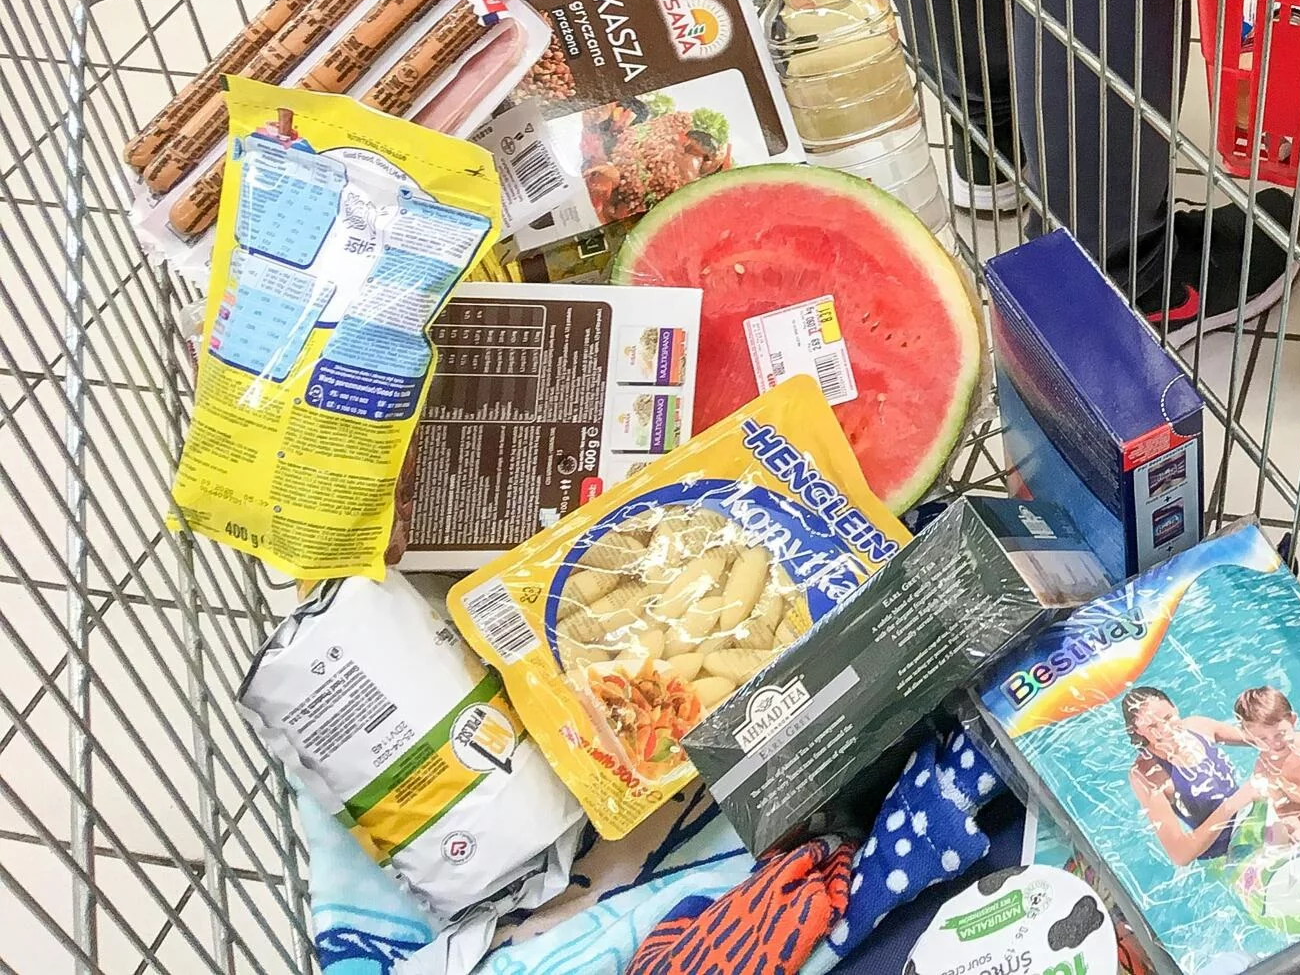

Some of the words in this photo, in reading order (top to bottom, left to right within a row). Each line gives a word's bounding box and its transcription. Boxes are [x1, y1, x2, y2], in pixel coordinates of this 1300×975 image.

[552, 8, 580, 56] prażona
[567, 0, 606, 67] gryczana
[659, 331, 671, 380] MULTIGRANO
[587, 439, 599, 447] g
[654, 398, 665, 447] MULTIGRANO
[584, 449, 596, 471] 400
[743, 421, 899, 563] HENGLEIN
[225, 520, 249, 542] 400
[881, 588, 903, 608] EARL
[899, 572, 922, 592] GREY
[1004, 607, 1151, 712] Bestway
[453, 718, 482, 750] POLSCE
[736, 704, 787, 747] AHMAD
[780, 685, 807, 709] TEA
[757, 734, 787, 760] EARL
[783, 712, 813, 737] GREY
[958, 904, 1023, 939] NATURALNA
[967, 953, 993, 972] sour
